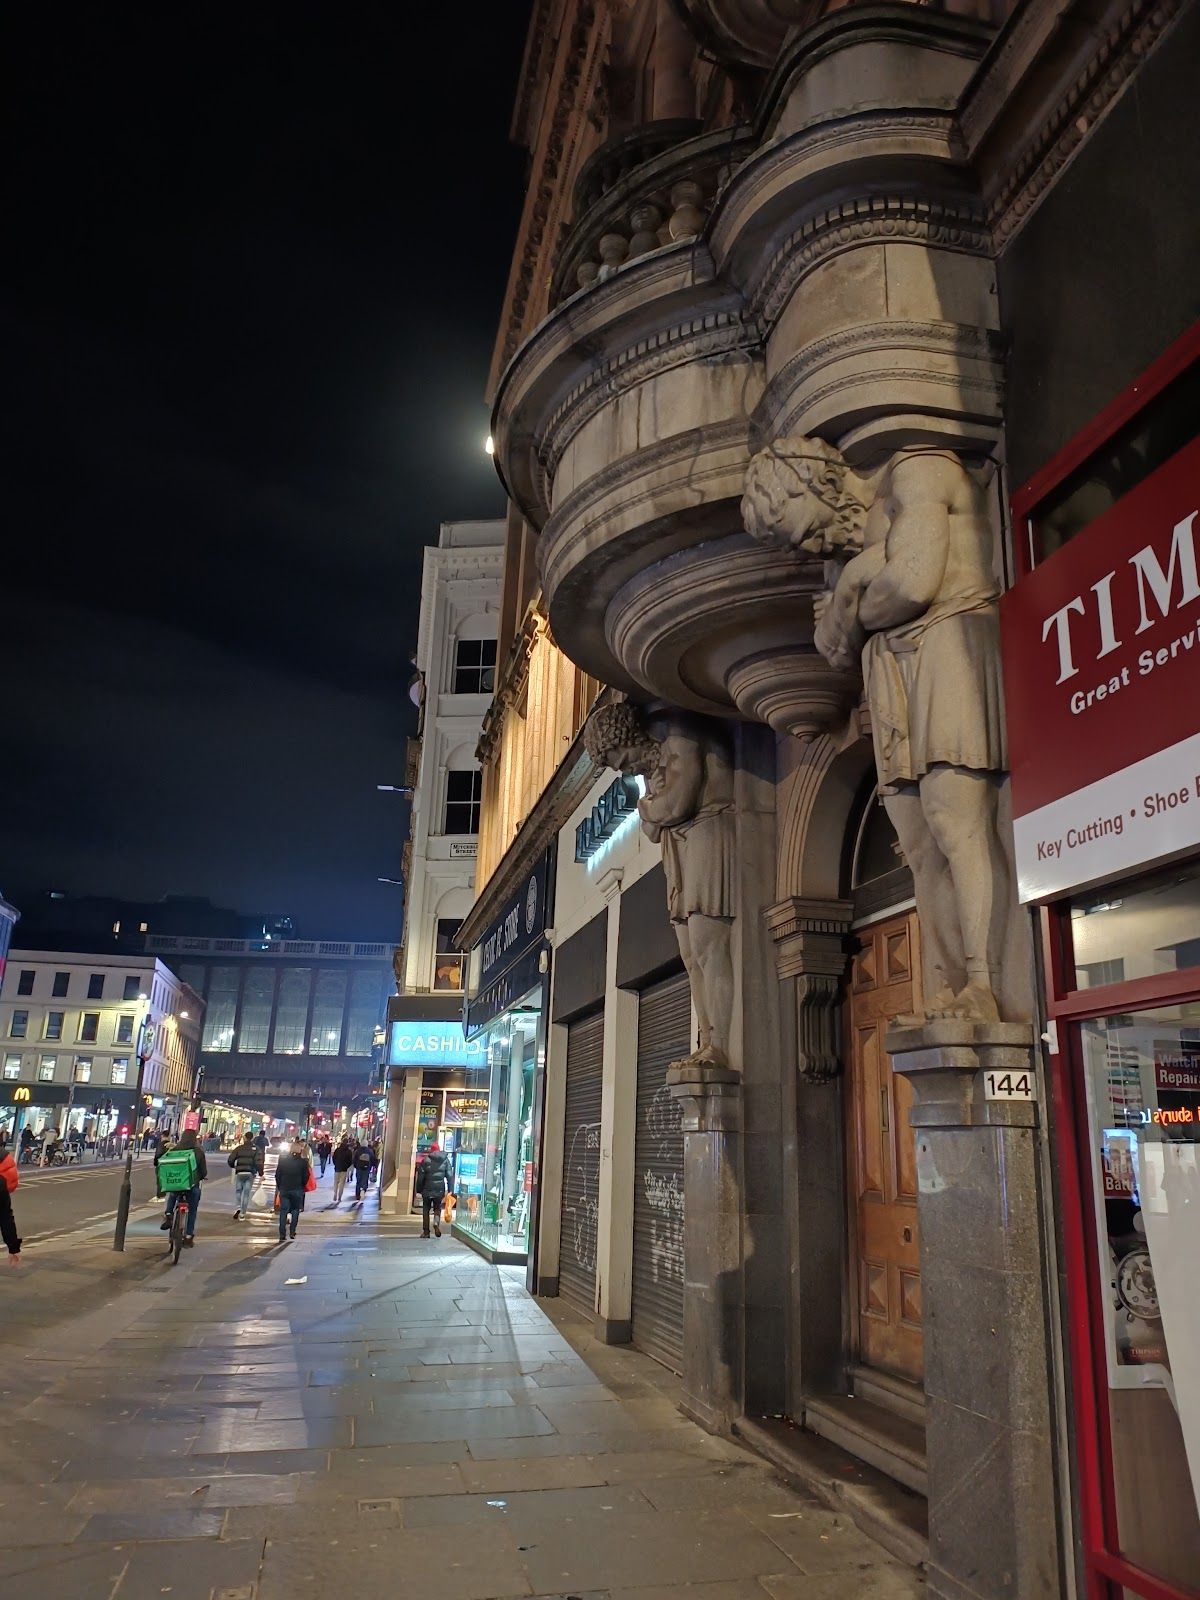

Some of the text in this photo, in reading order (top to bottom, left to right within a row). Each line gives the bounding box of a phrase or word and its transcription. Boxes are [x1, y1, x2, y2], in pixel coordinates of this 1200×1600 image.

[1041, 509, 1200, 686] TIM
[1070, 666, 1130, 715] Great
[1036, 787, 1190, 861] Key Cutting Shoe
[1159, 1053, 1198, 1068] Watch
[987, 1074, 1032, 1097] 144
